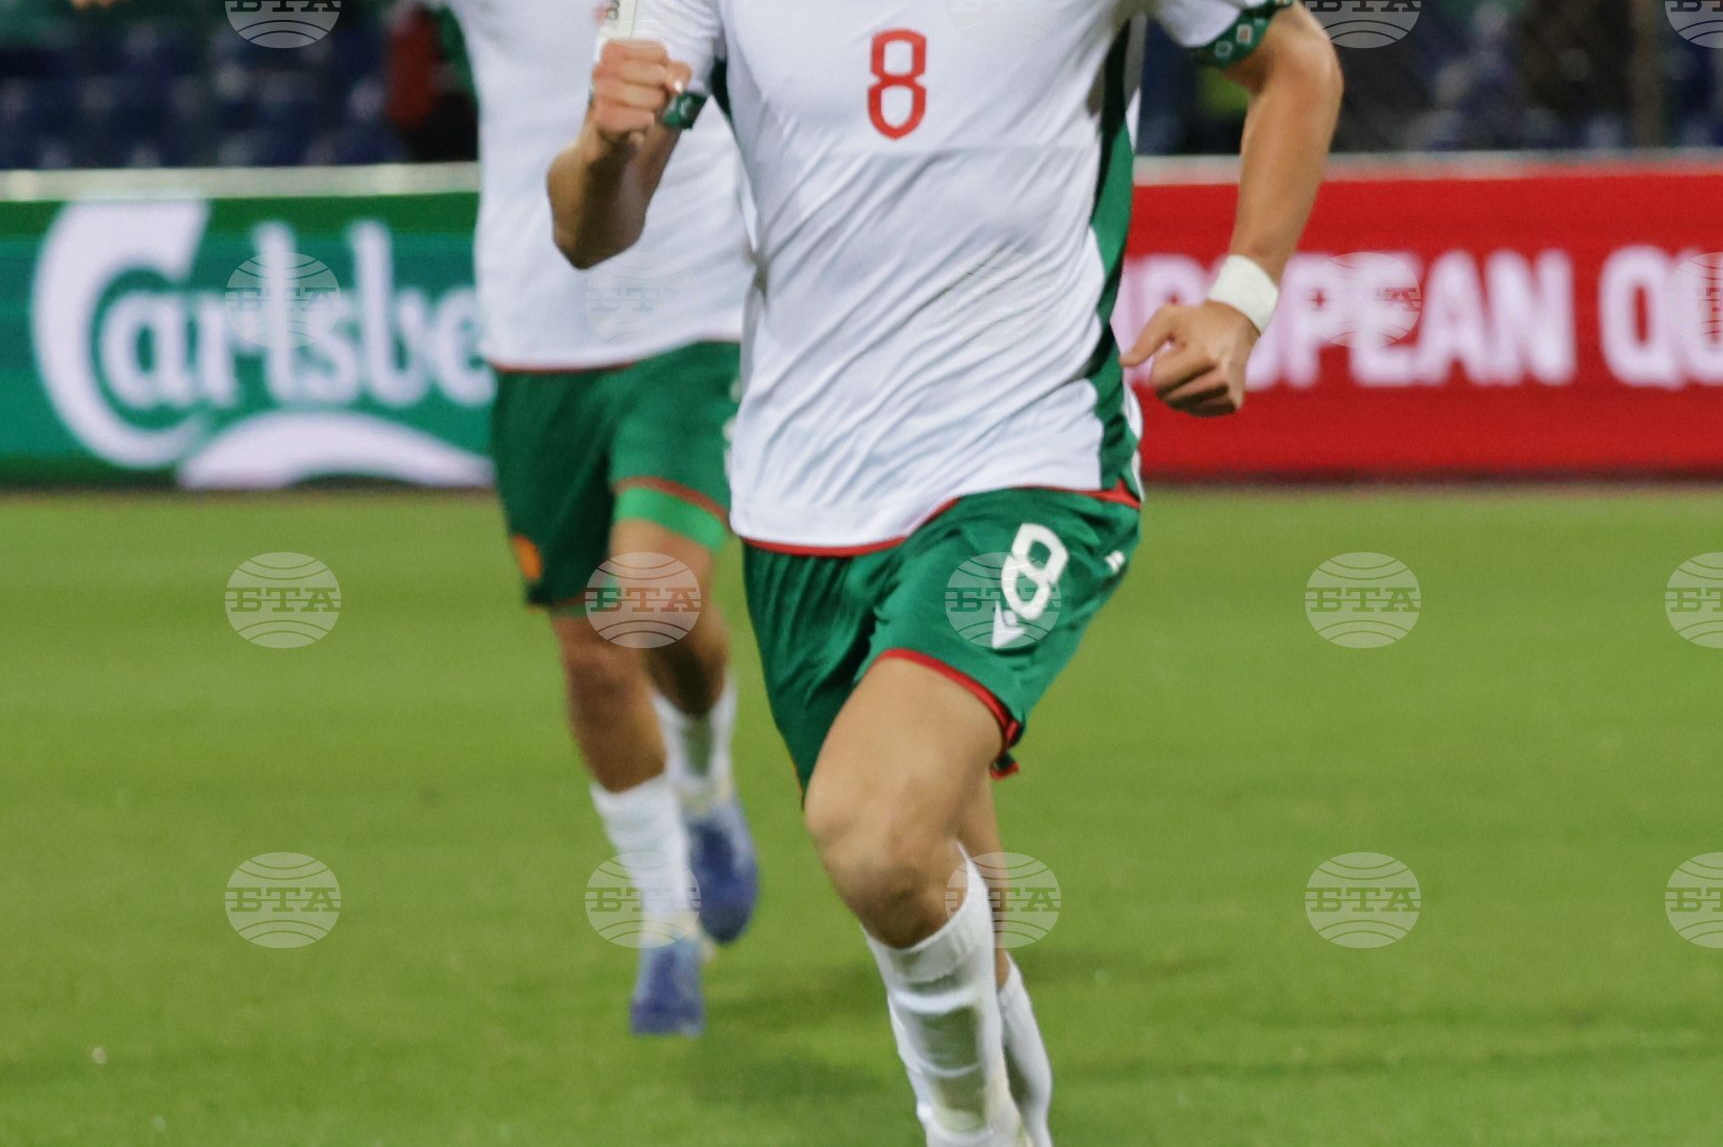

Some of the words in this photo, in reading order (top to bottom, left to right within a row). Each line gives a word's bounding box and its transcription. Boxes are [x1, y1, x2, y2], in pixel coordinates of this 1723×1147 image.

[867, 28, 927, 140] 8
[32, 196, 496, 468] Carlsbe
[1001, 522, 1069, 620] 8
